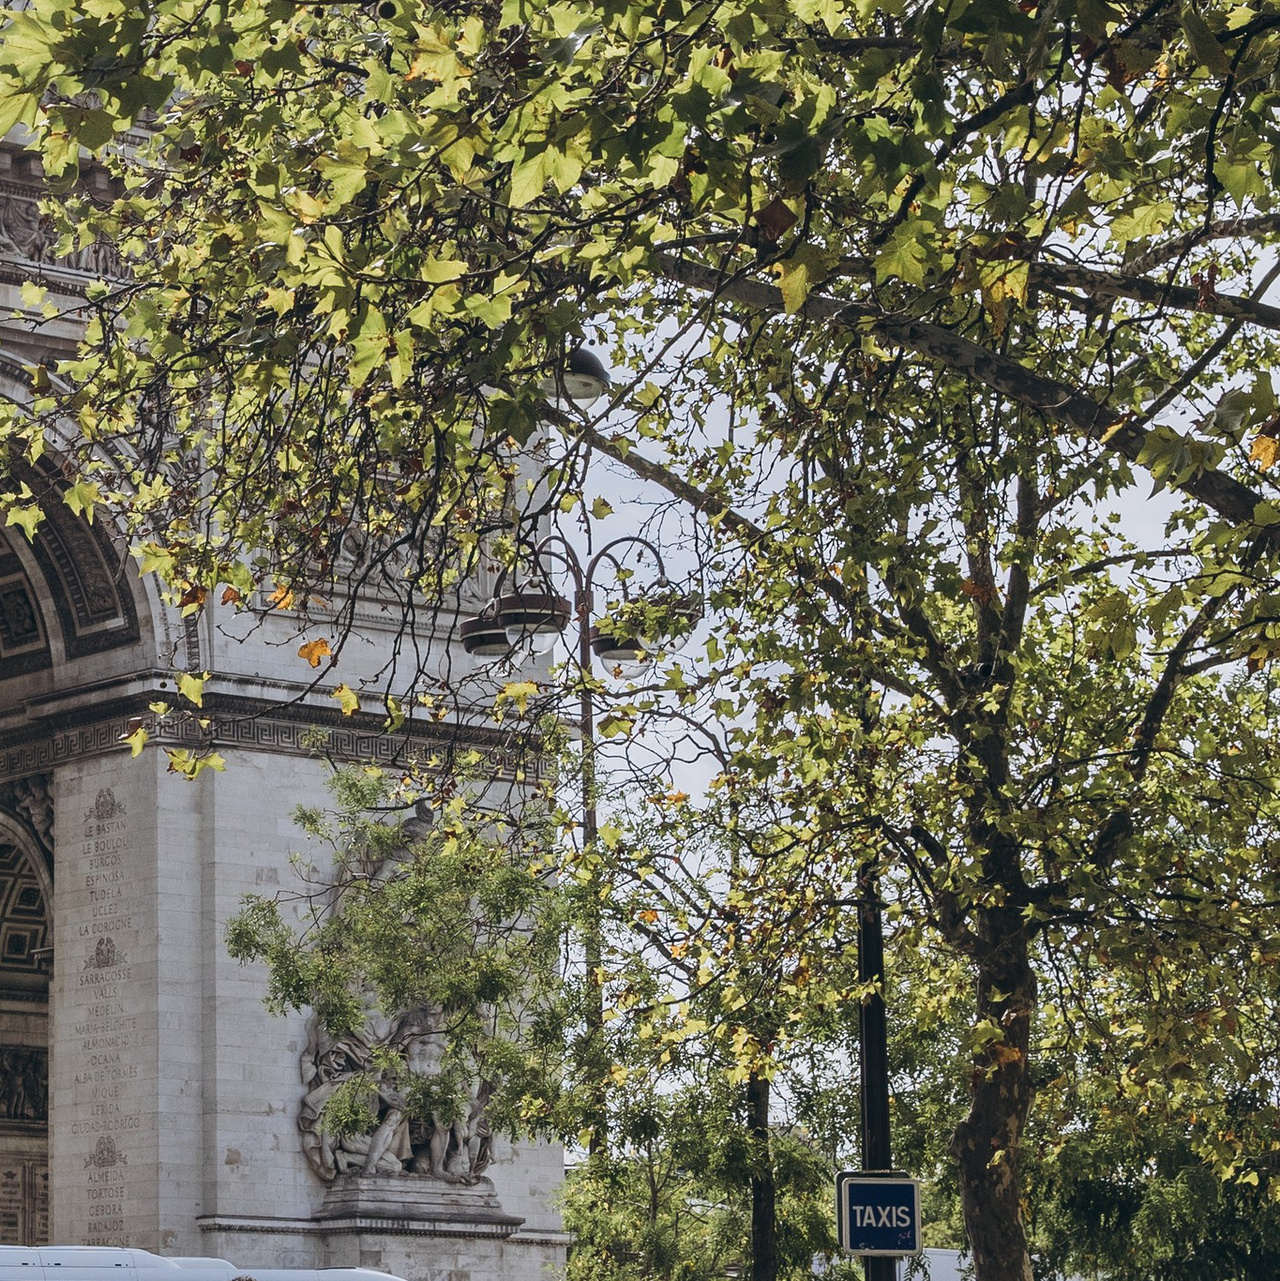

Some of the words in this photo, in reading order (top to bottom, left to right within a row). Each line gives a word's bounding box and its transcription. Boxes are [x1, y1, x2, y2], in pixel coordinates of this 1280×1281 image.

[84, 826, 93, 837] LE
[96, 820, 126, 835] BASTAN
[82, 843, 91, 855] LE
[95, 836, 128, 852] BOULOU
[89, 854, 122, 870] BURGOS
[86, 870, 125, 887] ESPINOSA
[89, 887, 122, 902] TUDELA
[79, 926, 89, 937] LA
[92, 918, 132, 934] COROGNE
[88, 1170, 125, 1183] ALMEIDA
[87, 1186, 125, 1200] TORTOSE
[852, 1205, 911, 1228] TAXIS
[88, 1220, 124, 1233] BADAJOZ
